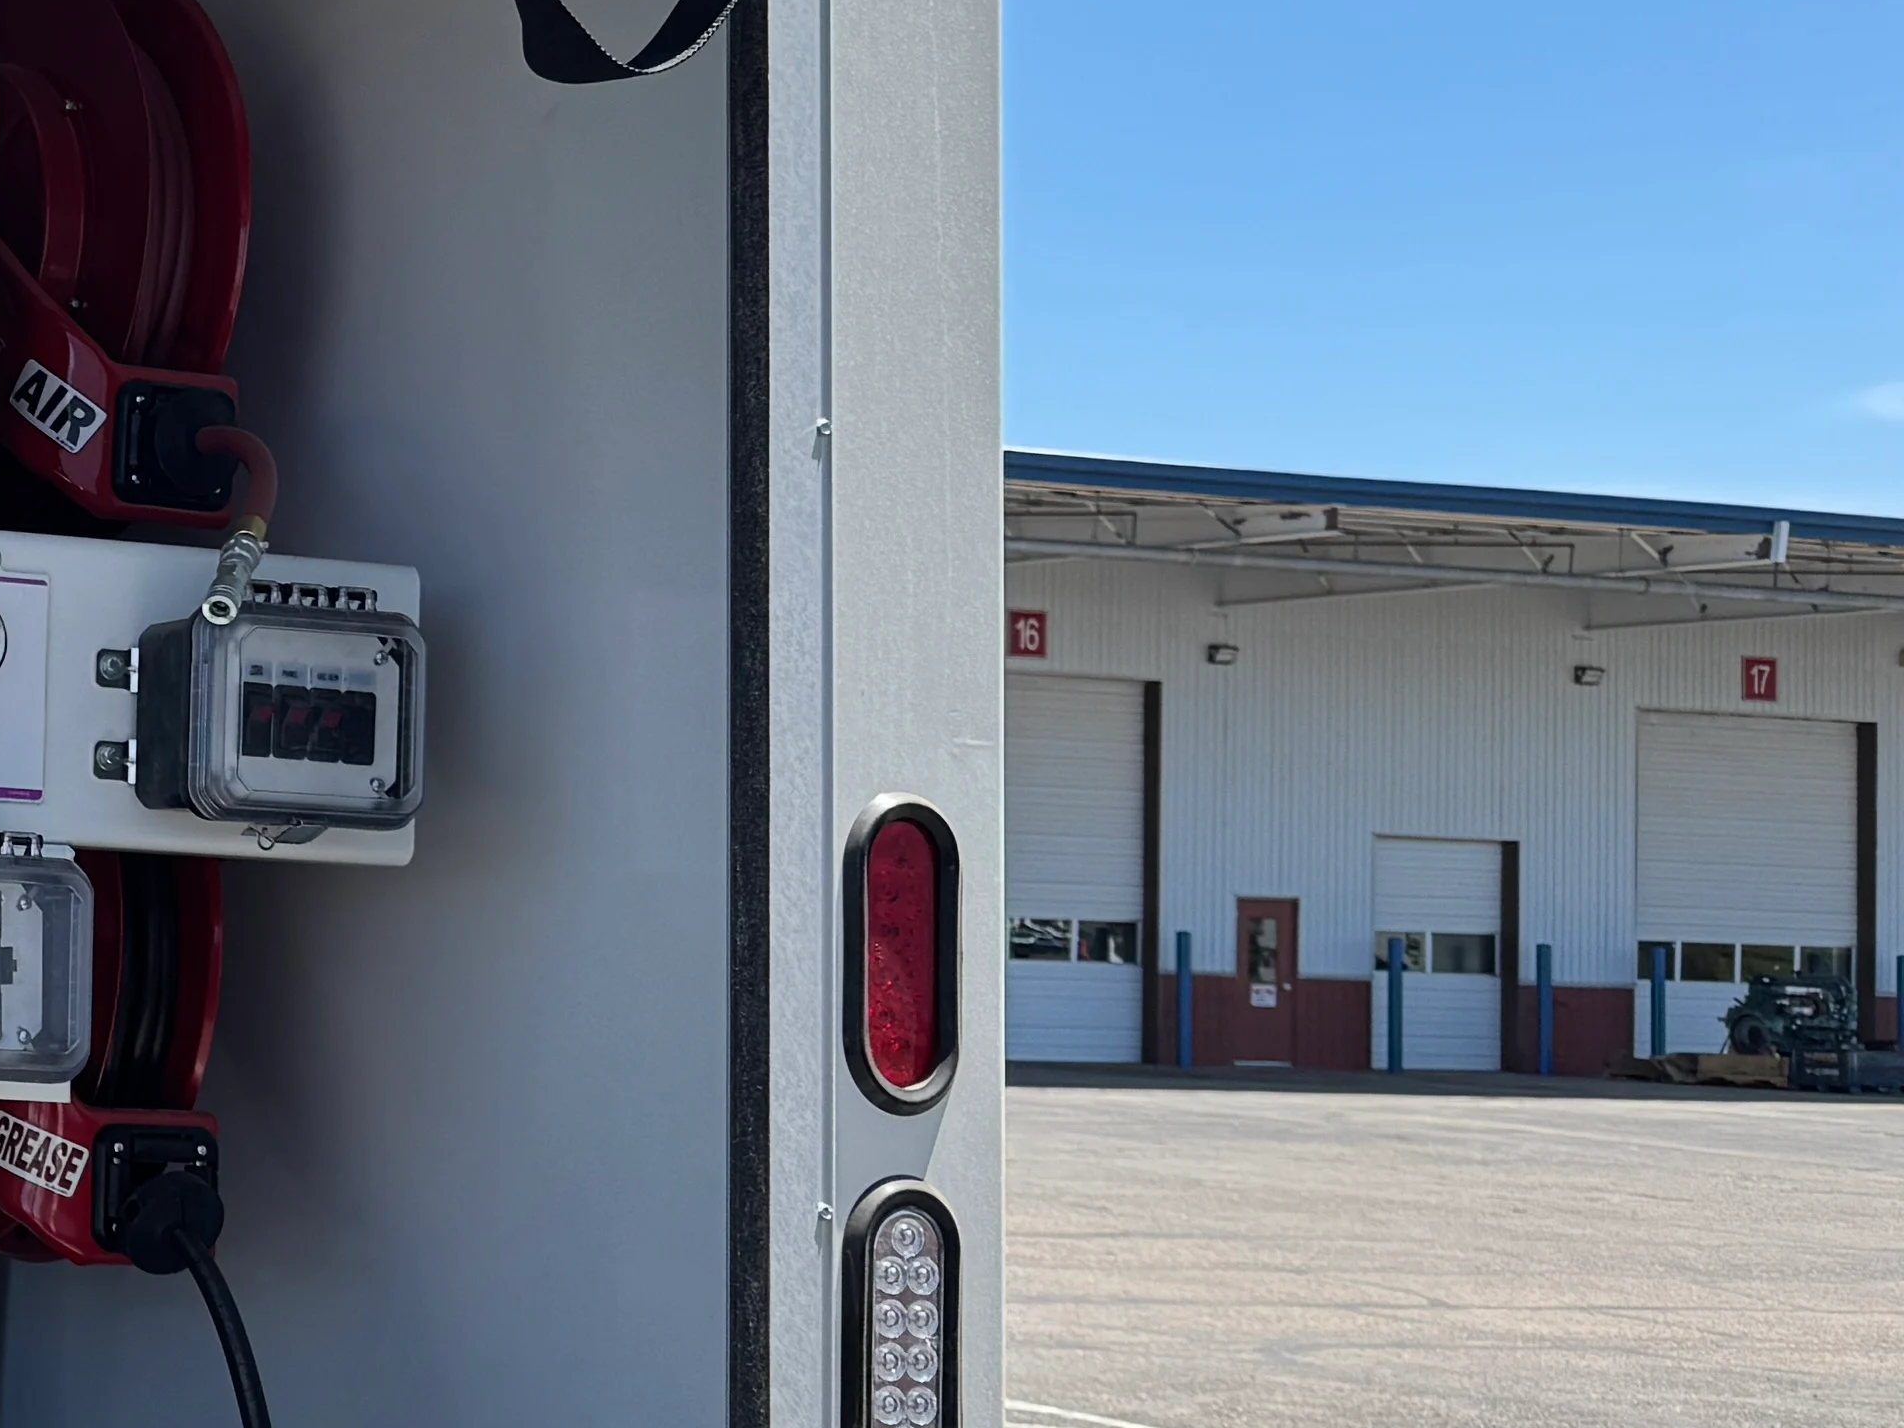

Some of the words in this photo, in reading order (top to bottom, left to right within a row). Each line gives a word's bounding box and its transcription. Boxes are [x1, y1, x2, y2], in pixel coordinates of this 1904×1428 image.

[15, 367, 98, 450] AIR
[1015, 619, 1039, 651] 16
[1750, 665, 1770, 694] 17
